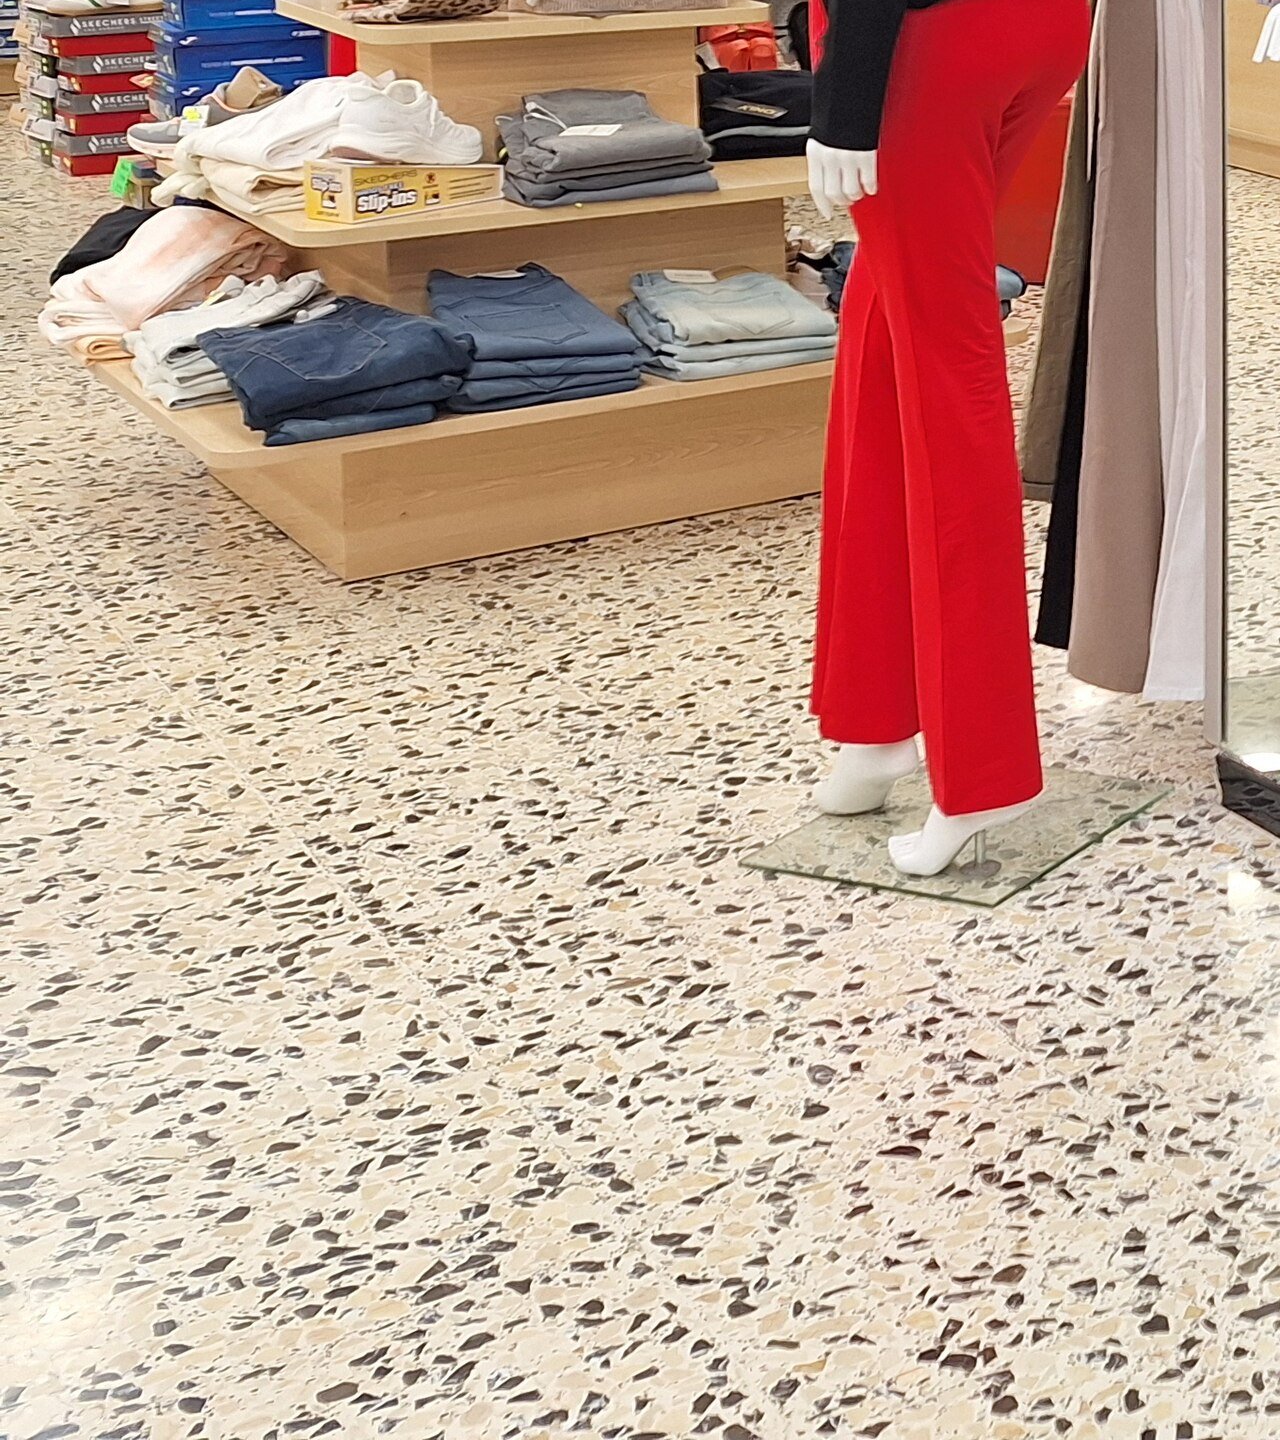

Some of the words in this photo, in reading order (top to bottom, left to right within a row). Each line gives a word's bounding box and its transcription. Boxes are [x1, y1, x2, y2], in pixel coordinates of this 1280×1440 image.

[81, 17, 137, 28] SKECHERS
[354, 170, 417, 186] SKECHERS
[356, 189, 419, 213] Slip-ins
